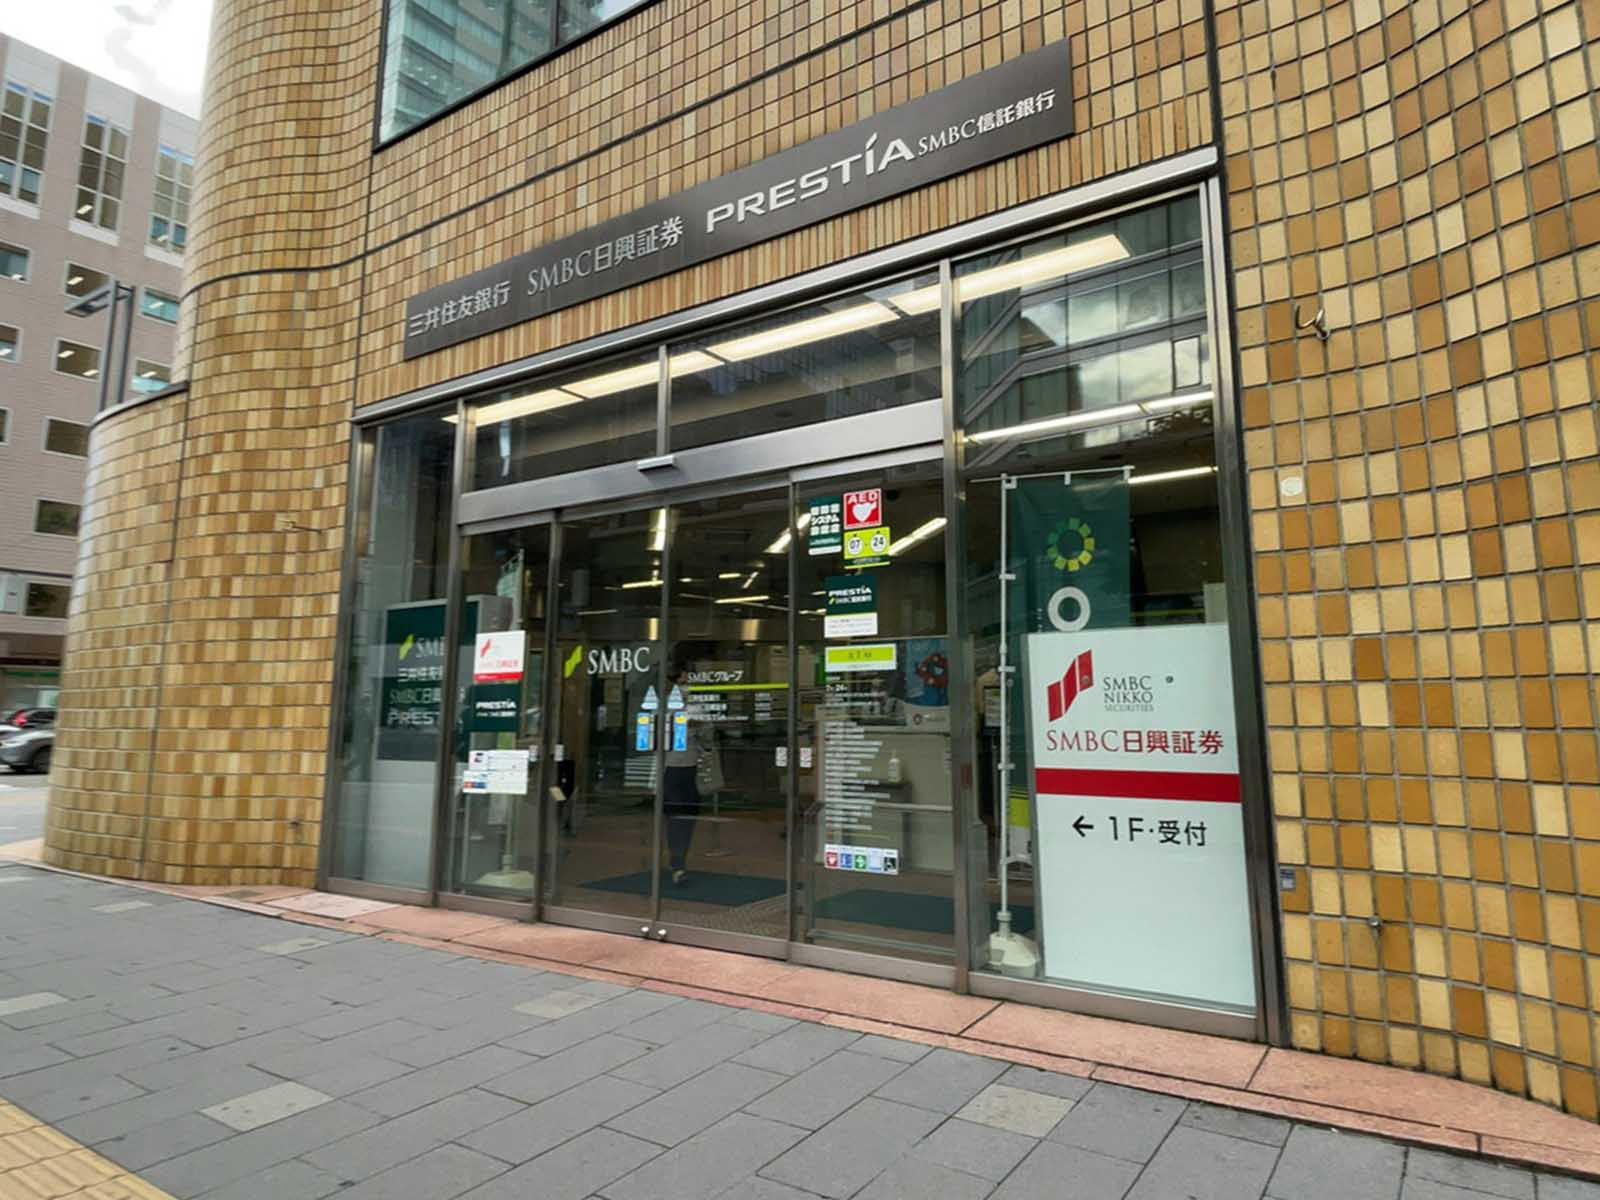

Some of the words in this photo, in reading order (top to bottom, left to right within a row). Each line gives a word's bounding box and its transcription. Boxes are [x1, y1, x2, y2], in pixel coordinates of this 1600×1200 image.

[408, 281, 511, 337] 三井住友銀行
[527, 216, 684, 296] SMBC日興証券
[705, 132, 917, 233] PRESTÍA
[917, 89, 1056, 157] SMBC信託銀行
[847, 491, 879, 504] AED
[588, 647, 650, 674] SMBC
[1103, 675, 1152, 691] SMBC
[1103, 691, 1154, 704] NIKKO
[1046, 729, 1224, 755] SMBC日興証券
